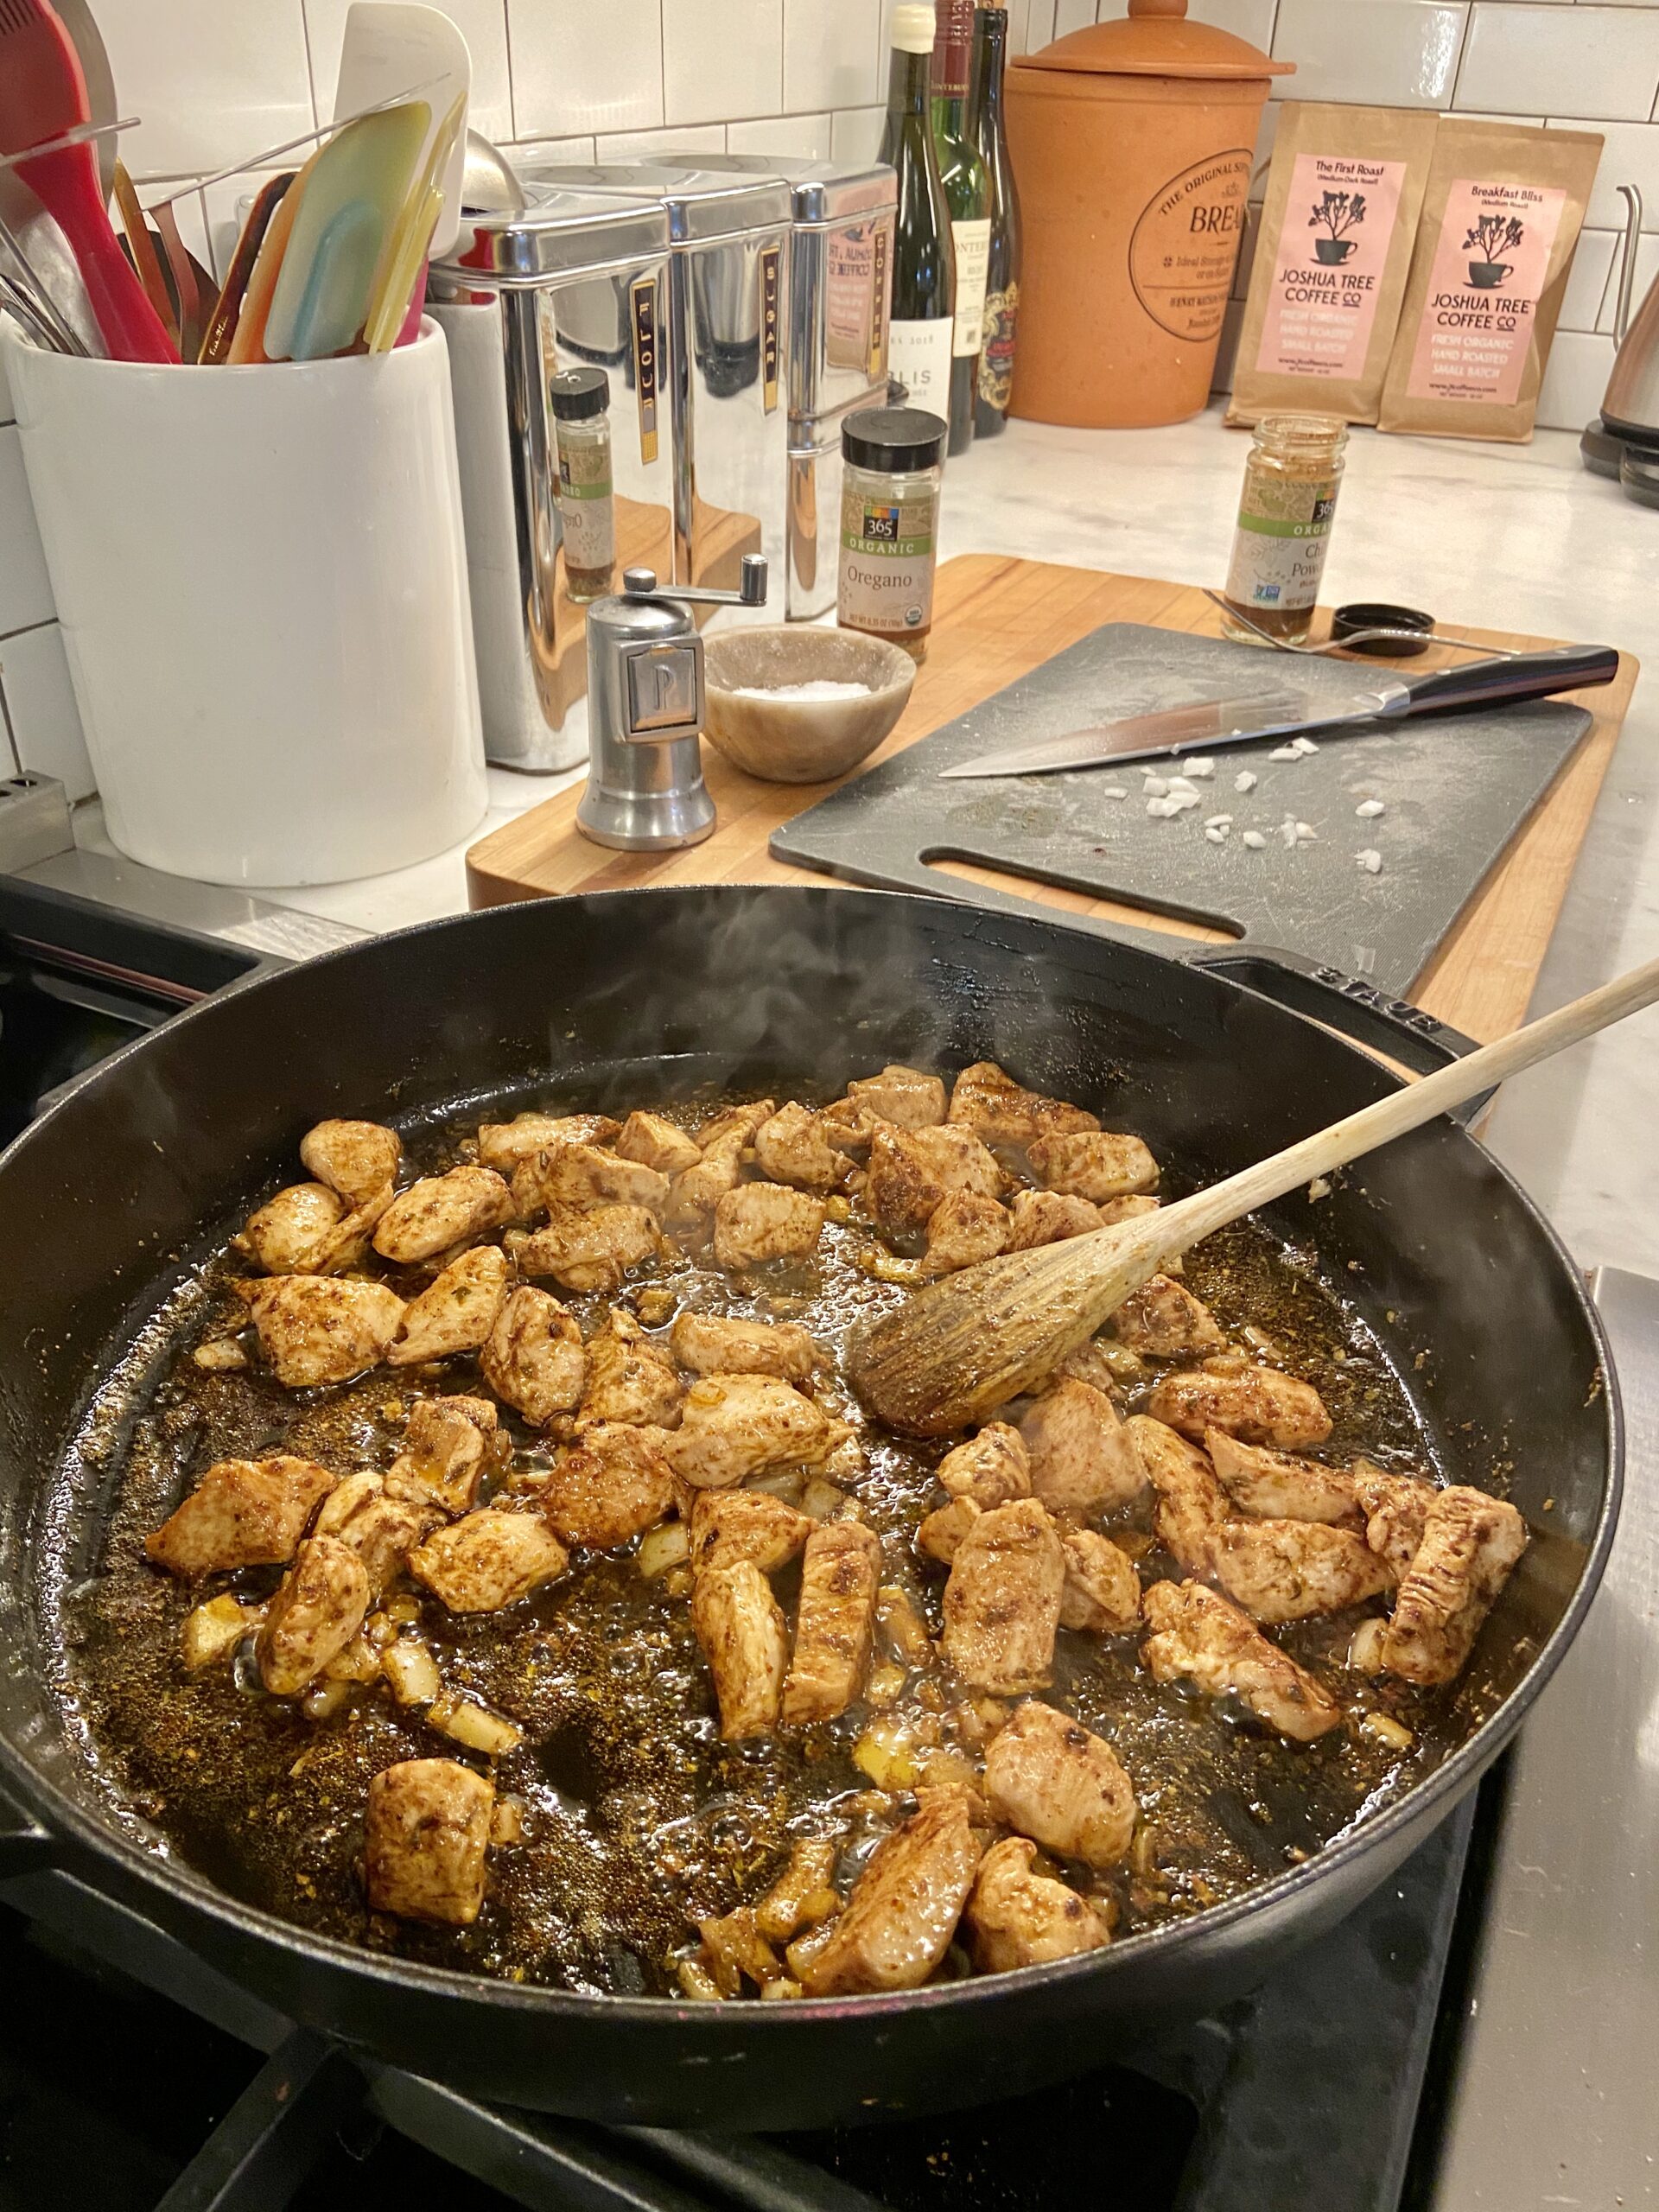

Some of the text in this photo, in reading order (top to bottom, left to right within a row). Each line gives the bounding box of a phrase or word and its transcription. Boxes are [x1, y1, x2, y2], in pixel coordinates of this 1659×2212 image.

[1316, 160, 1384, 176] The First Roast
[1159, 191, 1184, 217] THE
[1185, 162, 1233, 194] ORIGINAL
[1471, 185, 1543, 202] Breakfast Bliss
[1190, 204, 1243, 234] BREA
[1279, 269, 1375, 290] JOSHUA TREE
[1285, 287, 1361, 307] COFFEE CO
[1432, 294, 1531, 314] JOSHUA TREE
[766, 266, 776, 363] SUGAR
[1437, 312, 1516, 331] COFFEE CO
[1463, 335, 1514, 350] ORGANIC
[639, 302, 653, 411] FLOUR
[1431, 348, 1508, 365] HAND ROASTED
[1432, 364, 1501, 379] SMALL BATCH
[868, 518, 893, 537] 365
[1294, 524, 1330, 536] ORGA
[849, 537, 915, 554] ORGANIC
[847, 565, 912, 591] Oregano
[653, 664, 674, 710] P
[1310, 966, 1444, 1033] STAUB
